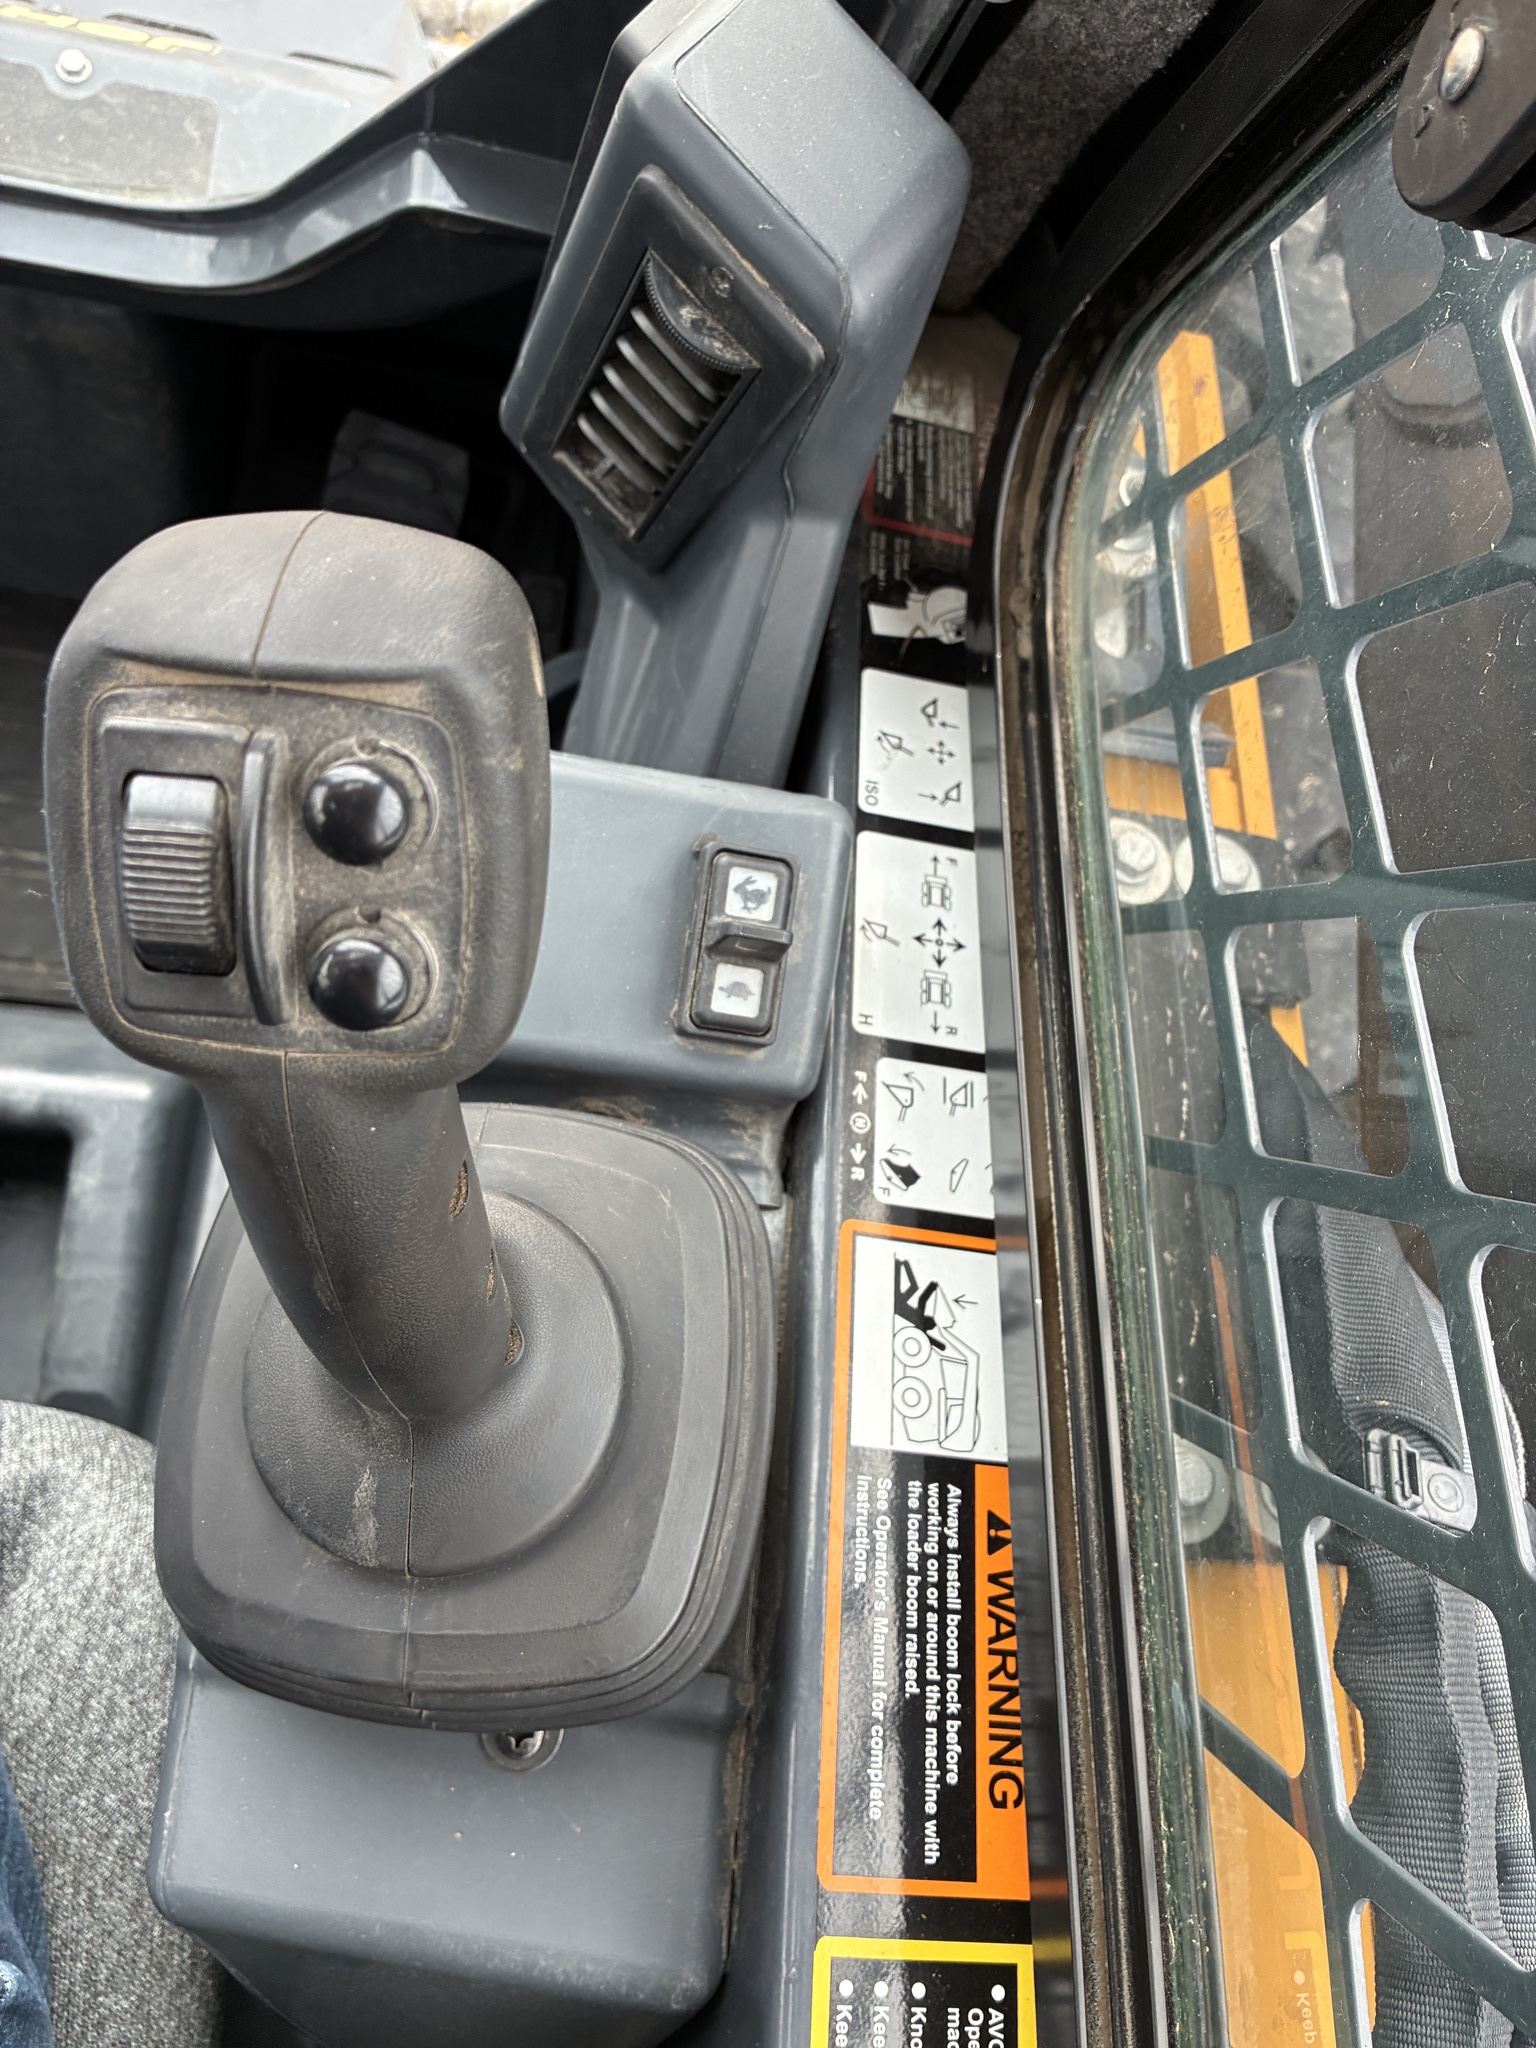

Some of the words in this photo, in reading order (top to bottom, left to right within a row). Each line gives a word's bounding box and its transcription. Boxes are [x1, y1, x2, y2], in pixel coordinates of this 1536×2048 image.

[865, 779, 879, 806] ISO
[946, 857, 958, 867] F
[858, 1014, 873, 1026] H
[946, 1026, 958, 1036] R
[854, 1071, 867, 1082] F
[851, 1167, 865, 1181] R
[878, 1187, 890, 1197] F
[876, 1477, 892, 1511] See
[907, 1480, 923, 1510] the
[854, 1474, 872, 1589] instructions.
[923, 1482, 942, 1555] working
[943, 1484, 962, 1549] Always
[873, 1515, 891, 1612] Operator's
[906, 1513, 922, 1572] loader
[926, 1558, 939, 1583] on
[946, 1553, 962, 1611] install
[906, 1574, 922, 1629] boom
[926, 1587, 939, 1609] or
[872, 1617, 889, 1687] Manual
[926, 1611, 941, 1681] around
[946, 1614, 962, 1669] boom
[904, 1633, 921, 1699] raised.
[871, 1692, 888, 1721] for
[925, 1685, 941, 1723] this
[946, 1673, 962, 1716] lock
[987, 1570, 1024, 1810] WARNING
[867, 1724, 886, 1821] complete
[924, 1727, 941, 1815] machine
[946, 1720, 962, 1785] before
[924, 1820, 941, 1865] with
[835, 2004, 853, 2048] Kee
[872, 2006, 890, 2048] Kee
